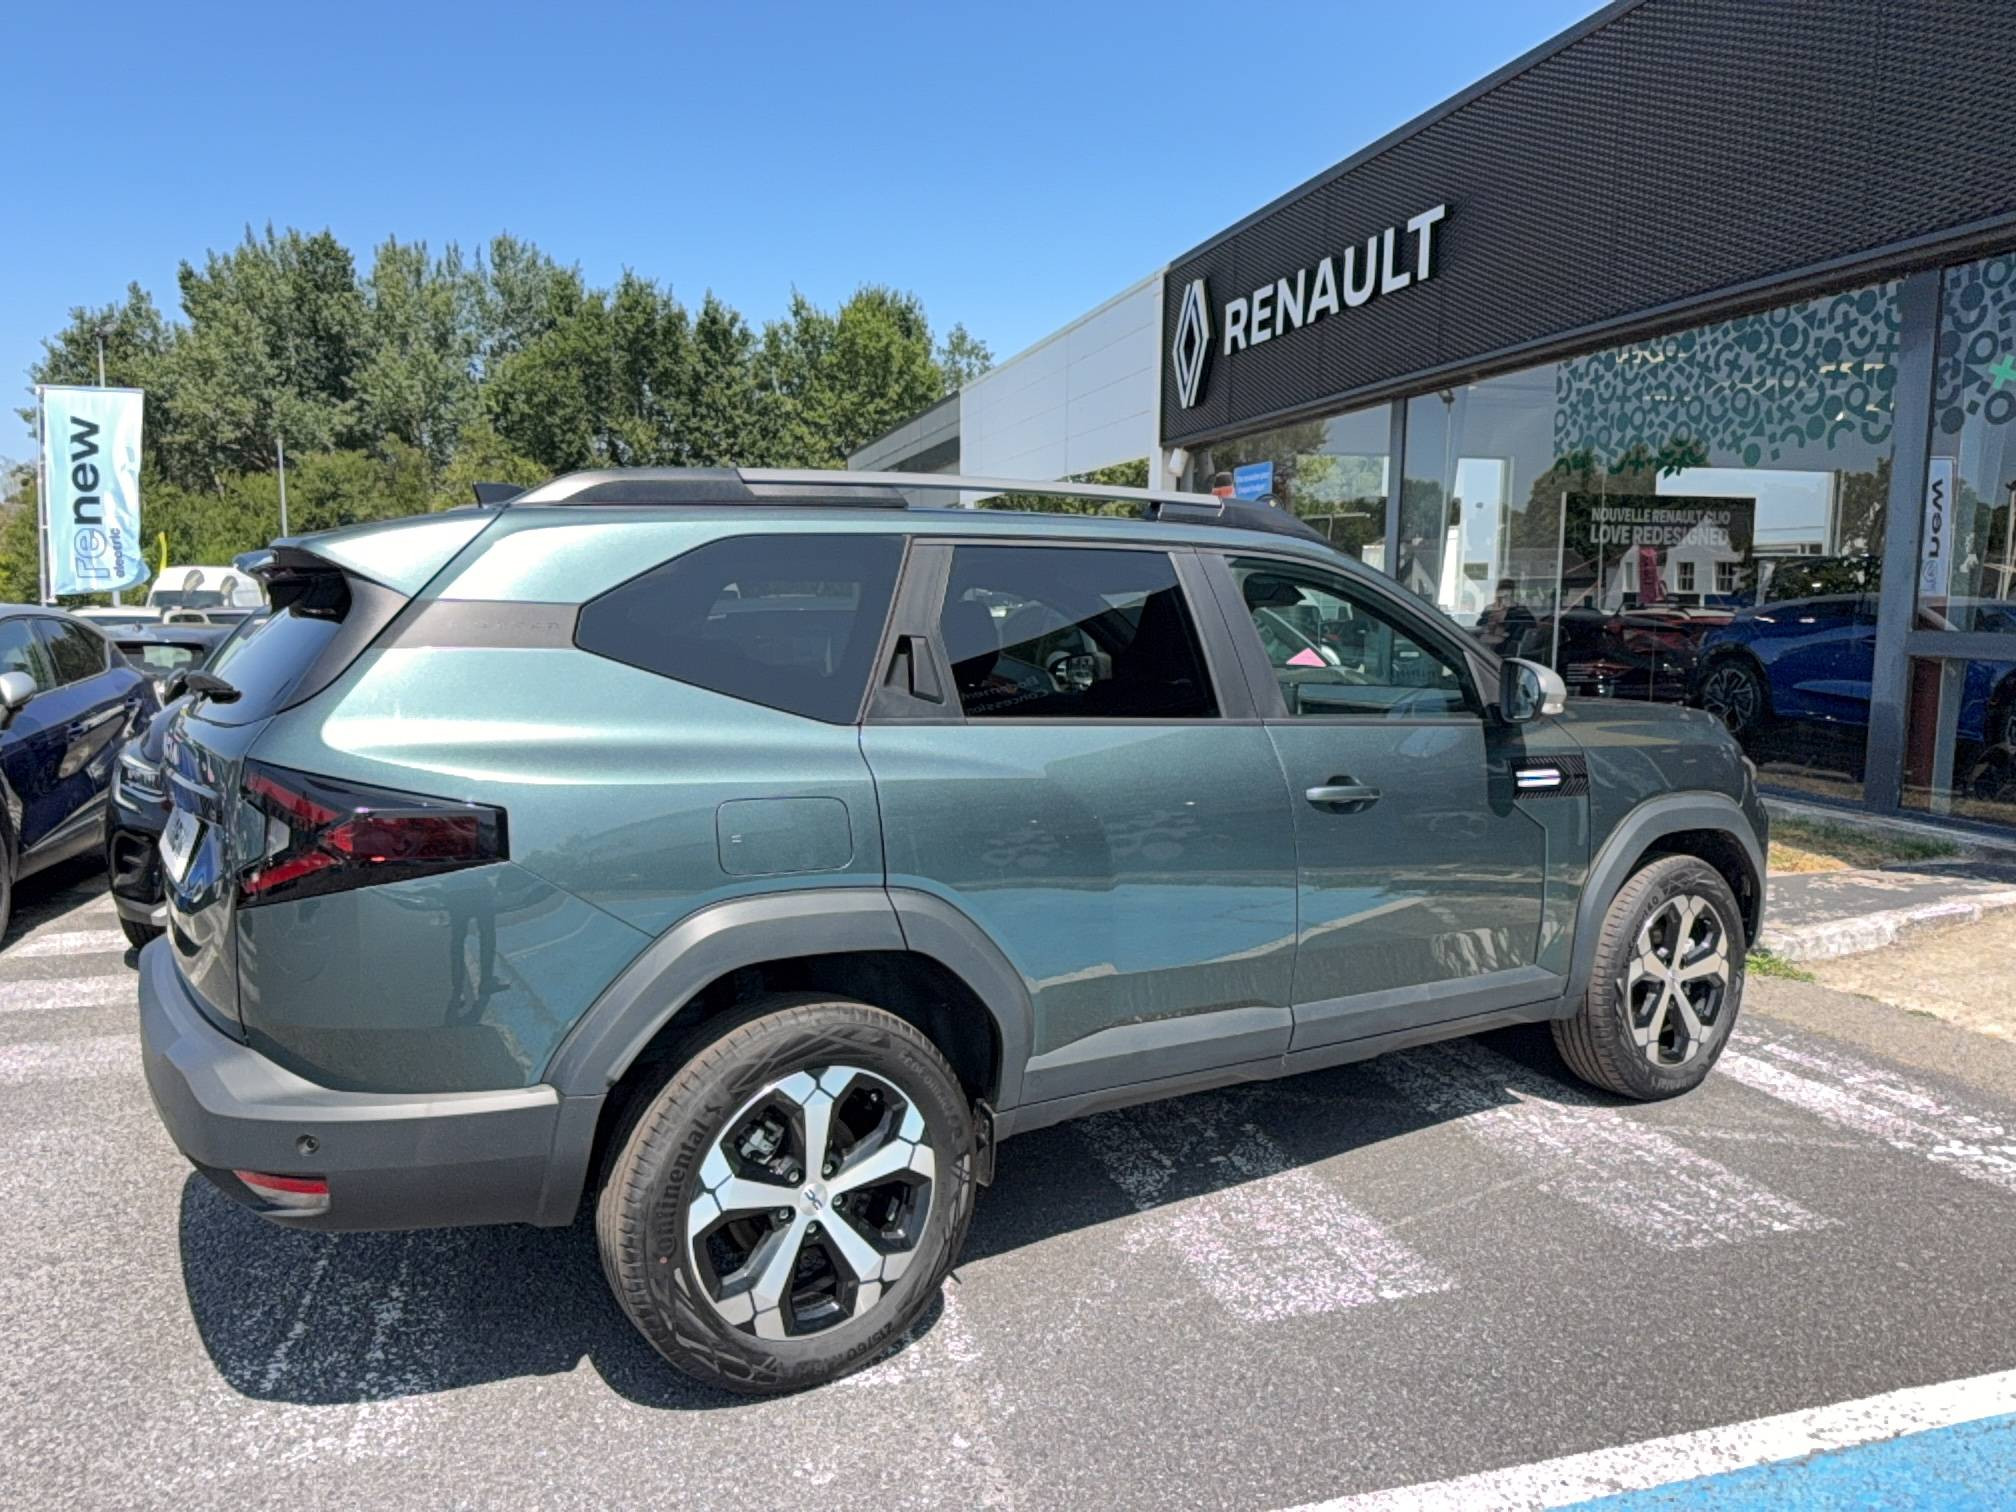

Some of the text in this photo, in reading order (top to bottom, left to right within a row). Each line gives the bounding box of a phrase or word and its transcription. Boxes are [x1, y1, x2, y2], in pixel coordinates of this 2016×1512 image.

[1224, 203, 1446, 356] RENAULT
[70, 415, 111, 579] renew
[1589, 525, 1729, 546] LOVE REDESIGNED
[1591, 507, 1731, 525] NOUVELLE RENAULT CLIO
[109, 527, 125, 578] electric
[657, 1121, 712, 1256] Continental
